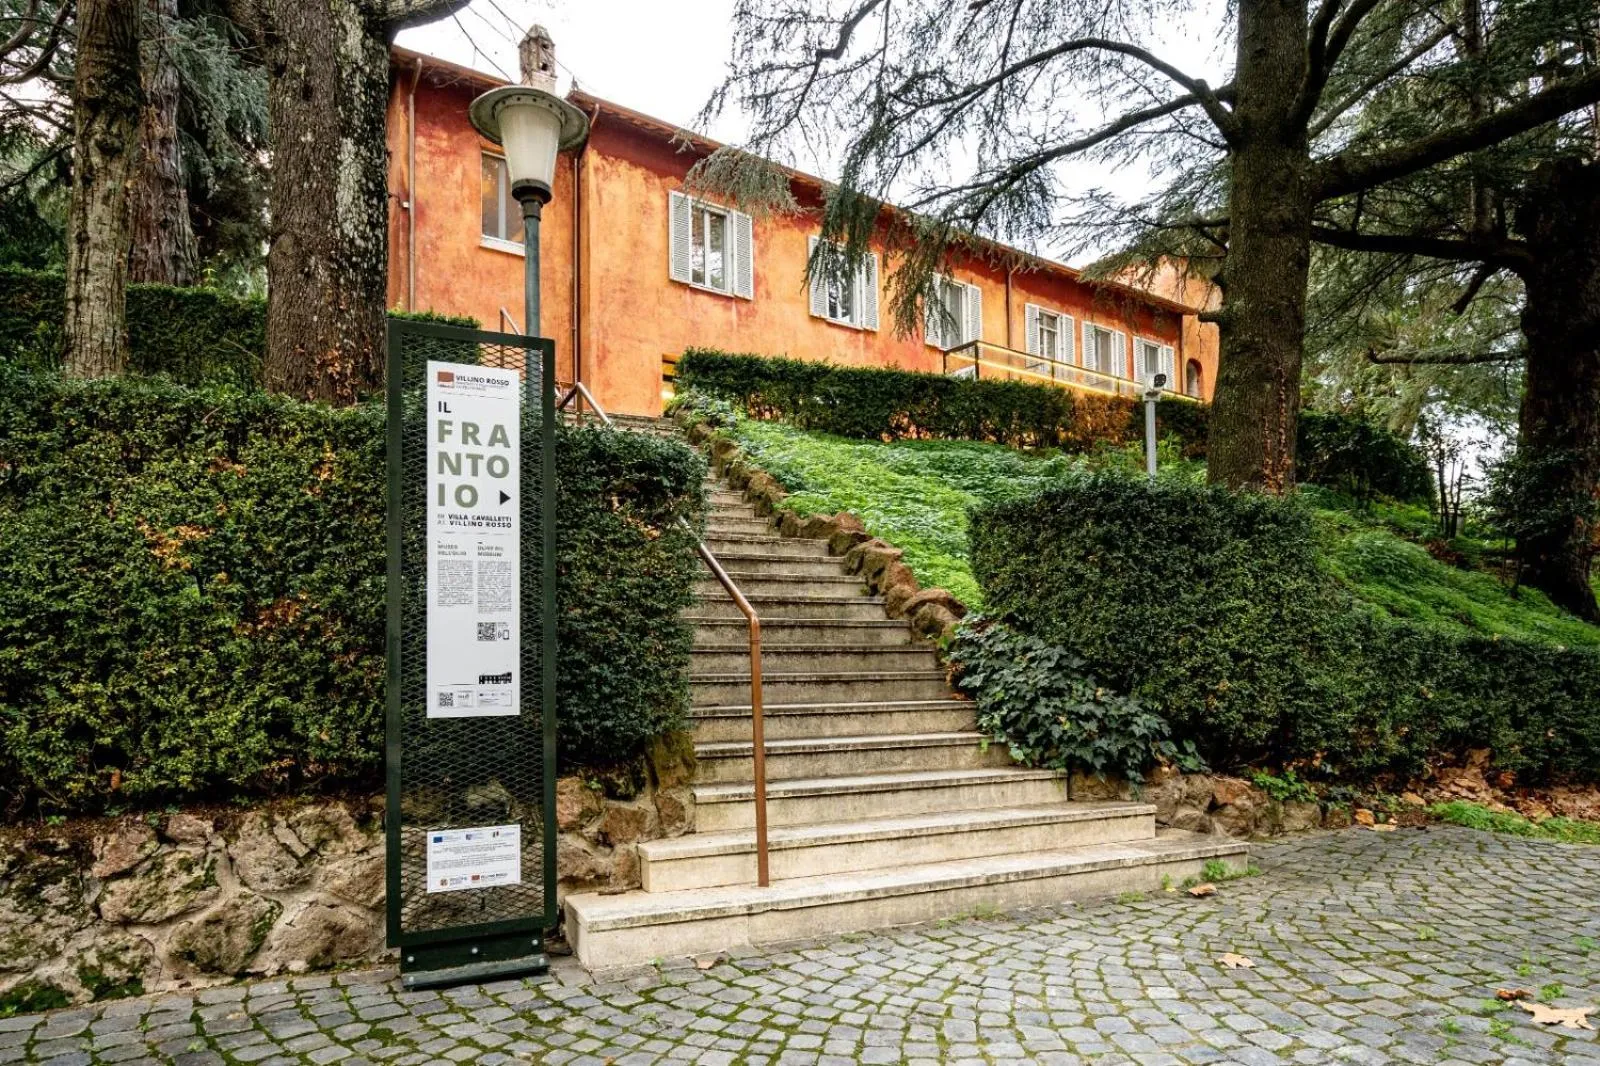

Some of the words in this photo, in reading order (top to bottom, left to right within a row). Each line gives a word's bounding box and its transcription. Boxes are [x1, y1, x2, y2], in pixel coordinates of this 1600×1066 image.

[456, 375, 485, 384] VILLINO
[486, 377, 510, 386] ROSSO
[438, 401, 452, 413] IL
[438, 419, 511, 448] FRA
[438, 452, 510, 479] NTO
[438, 483, 479, 508] IO
